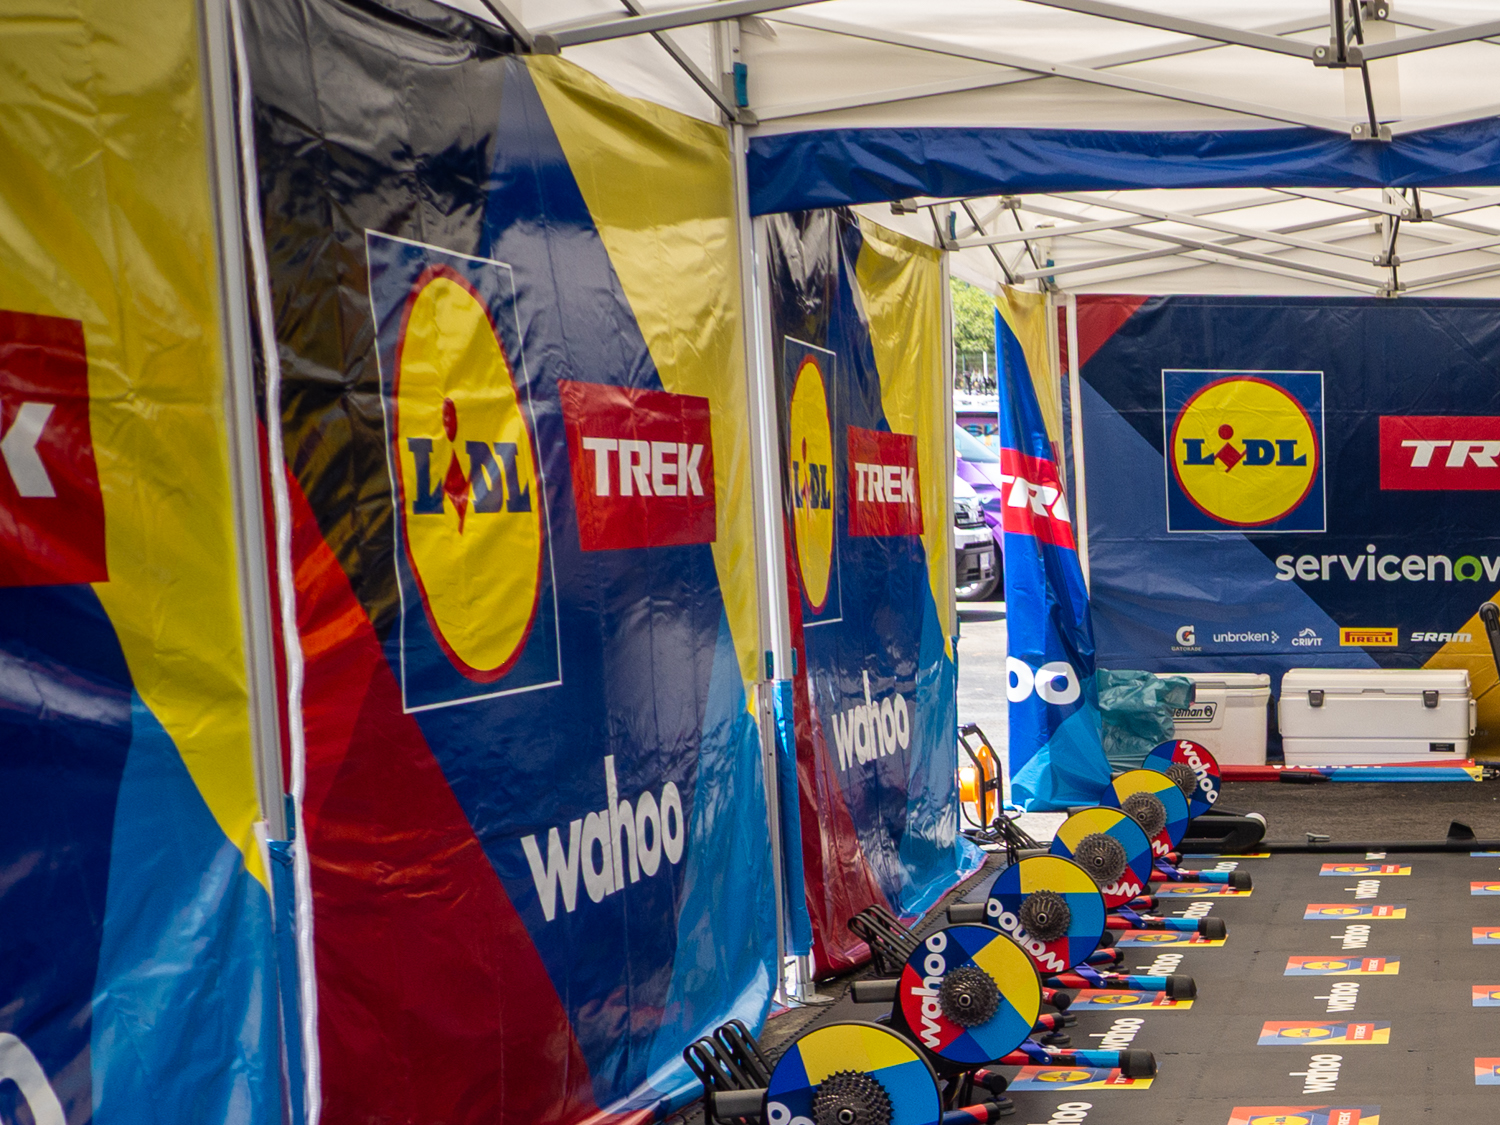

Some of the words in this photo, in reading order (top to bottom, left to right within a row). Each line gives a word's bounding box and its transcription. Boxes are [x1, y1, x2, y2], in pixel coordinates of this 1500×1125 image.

[583, 437, 704, 497] TREK
[855, 462, 914, 503] TREK
[1213, 631, 1269, 643] unbroken
[1291, 637, 1322, 646] CRIVIT
[1345, 631, 1393, 643] PIRELLI
[1410, 632, 1472, 642] SRAM
[831, 670, 910, 771] wahoo
[1180, 741, 1218, 803] wahoo
[521, 756, 684, 921] wahoo
[986, 897, 1065, 973] wahoo
[911, 931, 948, 1049] wahoo
[1313, 981, 1360, 1013] wahoo
[1354, 1024, 1367, 1039] TREK
[1288, 1053, 1344, 1095] wahoo
